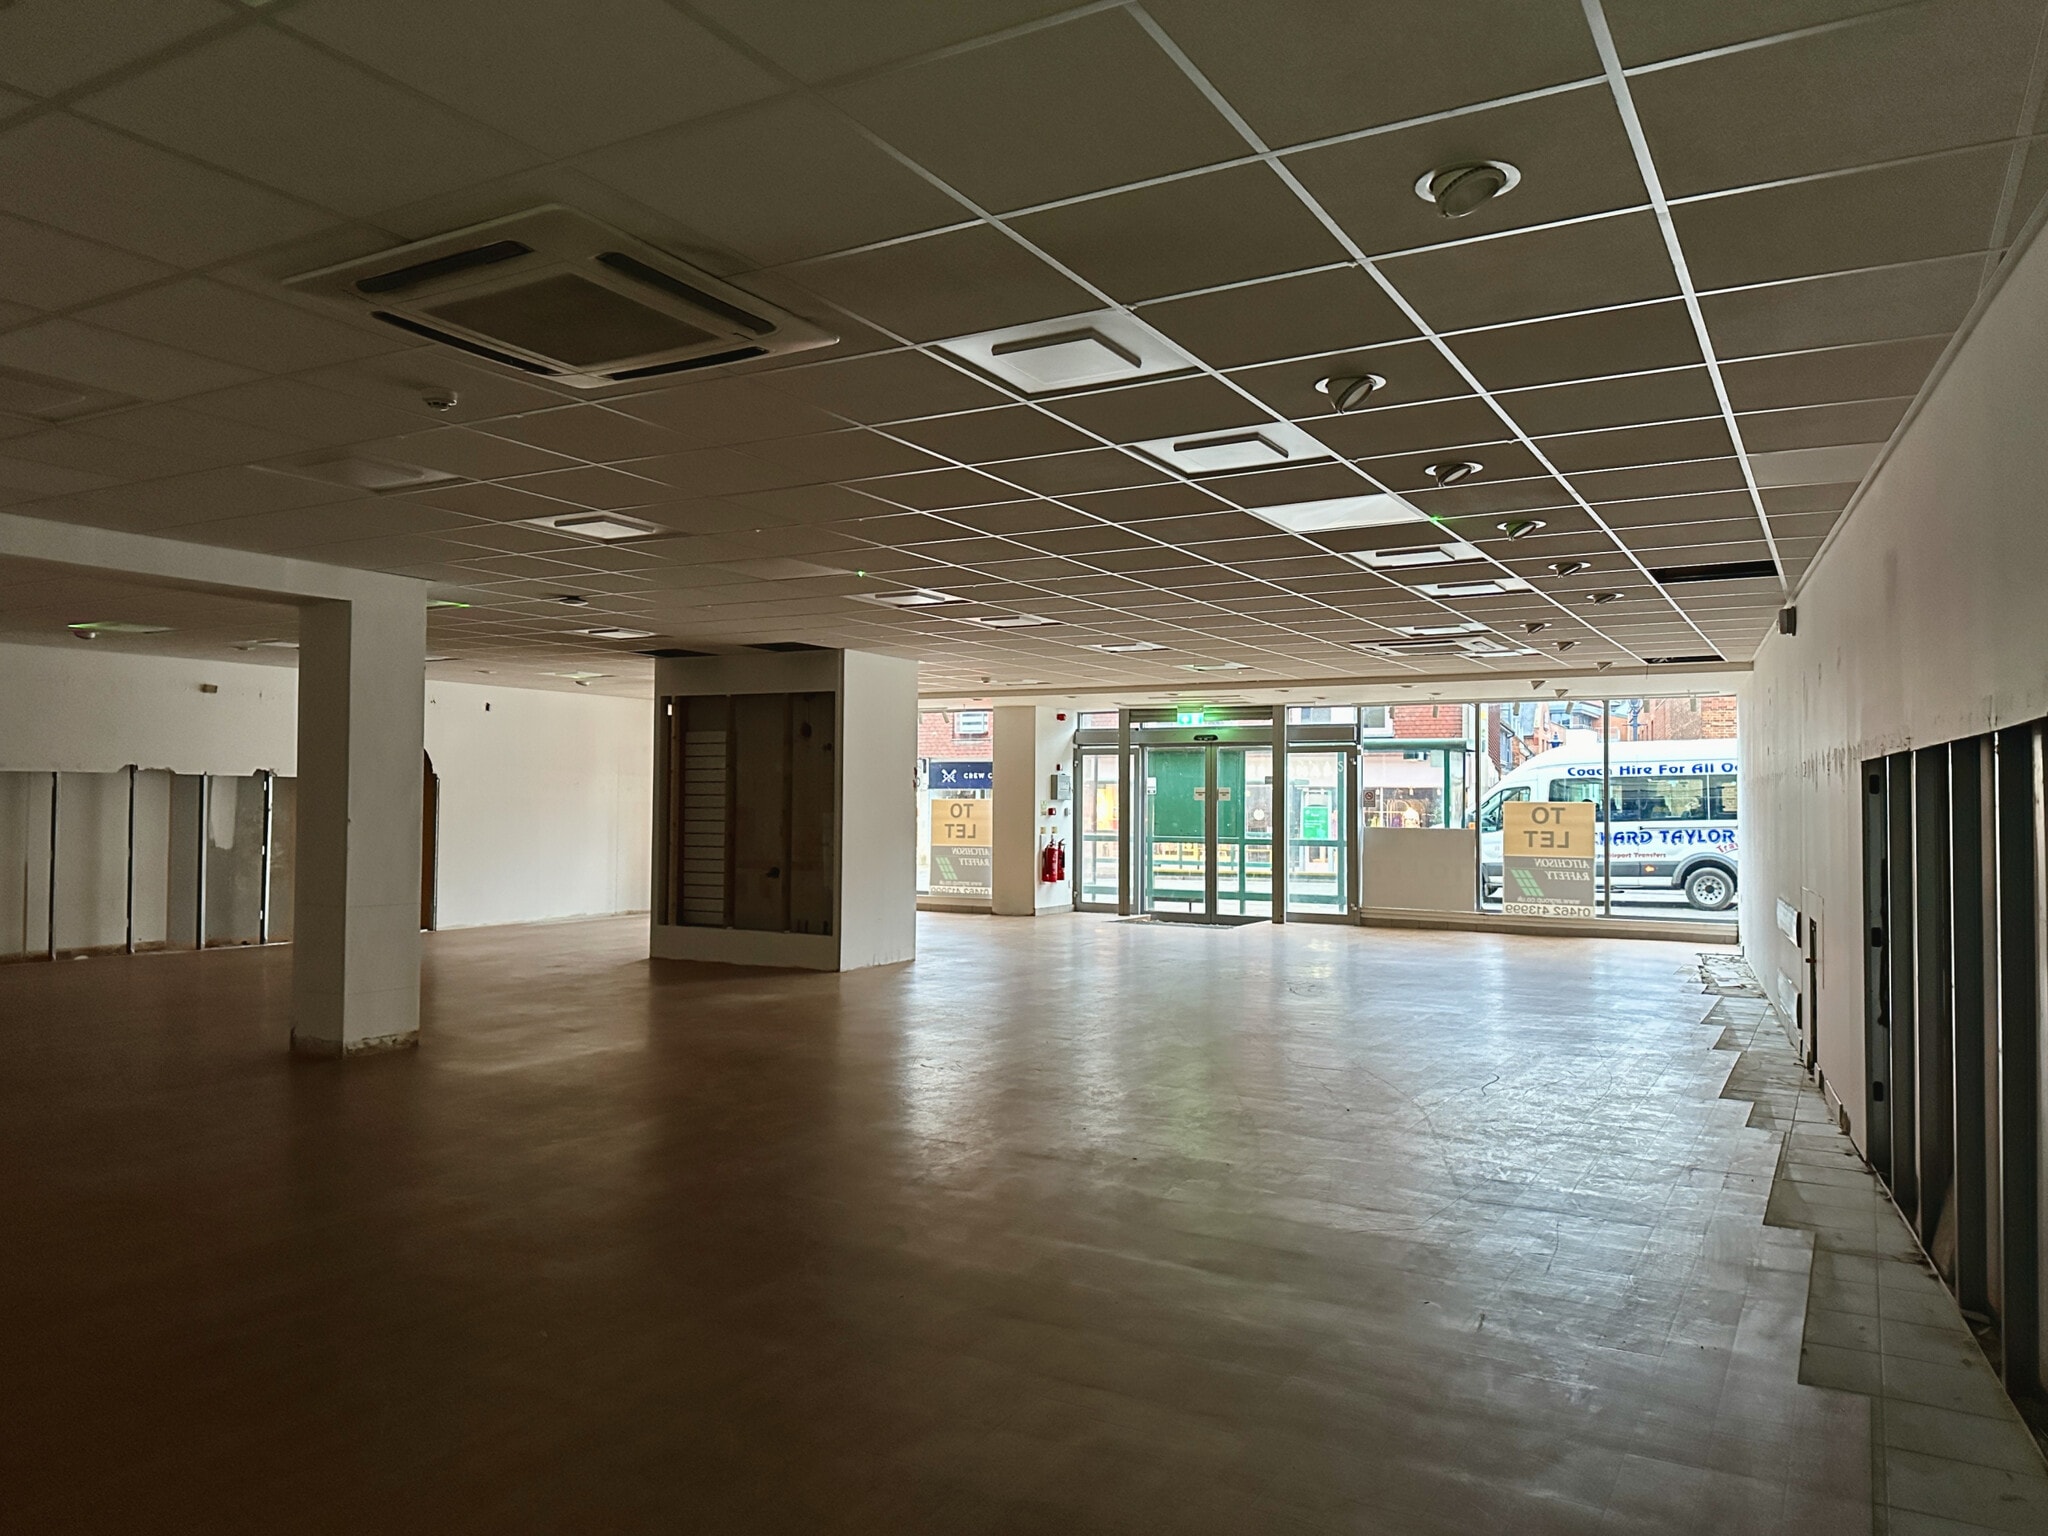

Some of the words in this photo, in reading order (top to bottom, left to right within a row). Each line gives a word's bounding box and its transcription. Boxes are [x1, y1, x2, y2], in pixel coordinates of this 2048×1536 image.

[1619, 765, 1652, 776] Hire
[1659, 764, 1685, 775] For
[1691, 763, 1714, 774] All
[1659, 829, 1736, 845] TAYLOR
